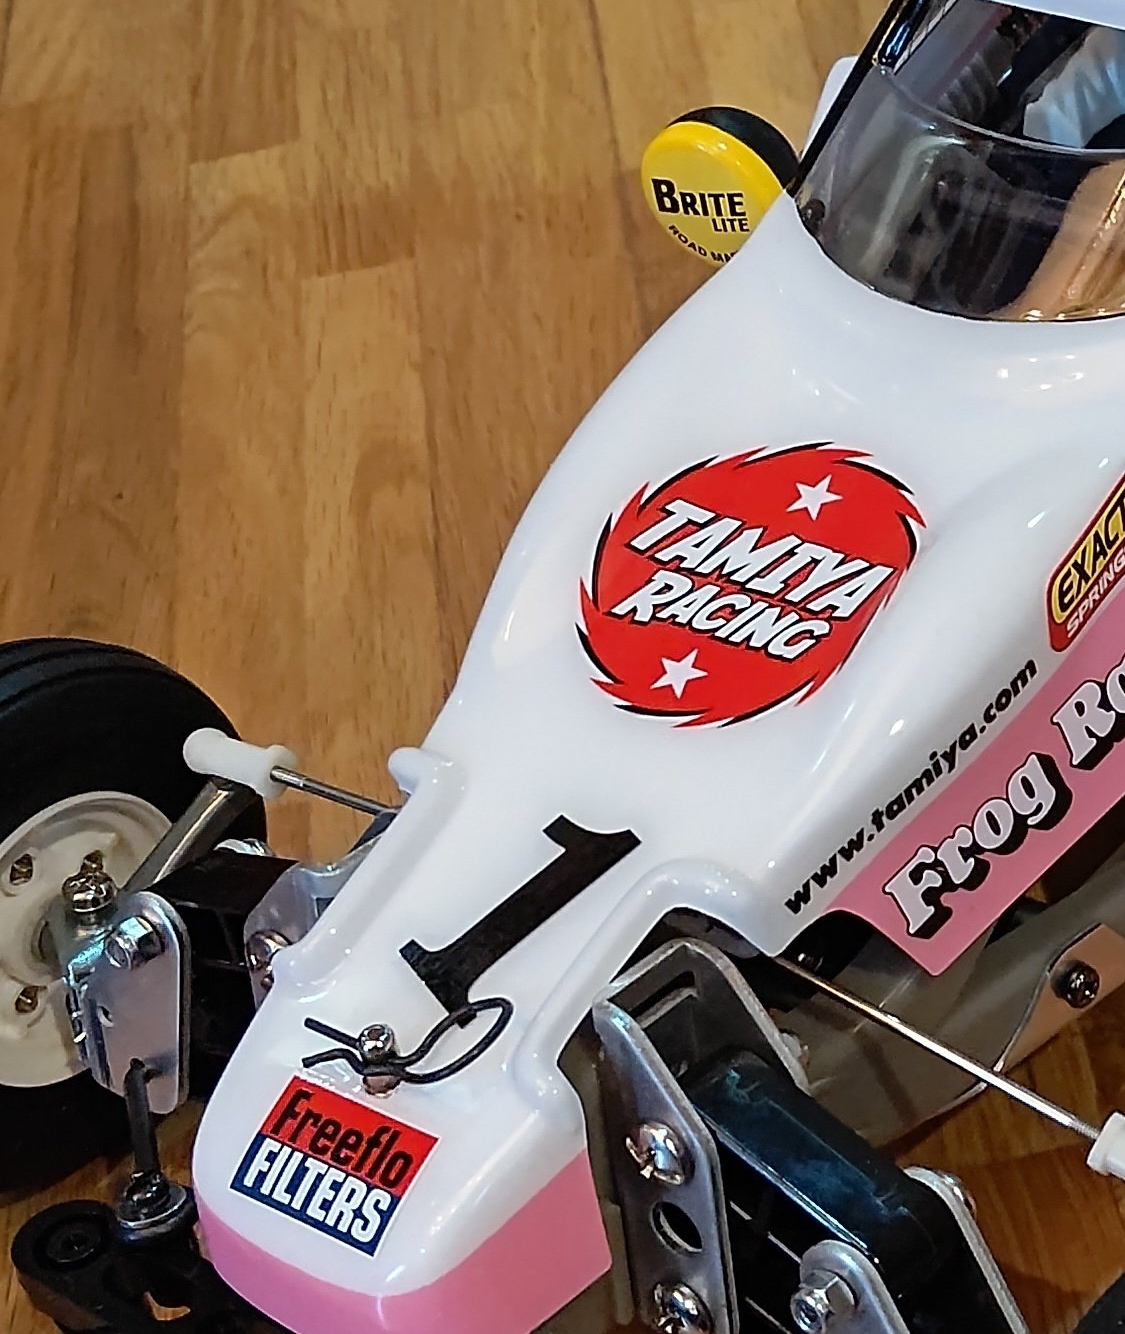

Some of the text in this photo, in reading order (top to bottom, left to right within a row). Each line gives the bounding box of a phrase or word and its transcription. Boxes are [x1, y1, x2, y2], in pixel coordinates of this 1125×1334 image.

[651, 178, 747, 217] BRITE
[668, 225, 708, 257] ROAD
[711, 218, 750, 233] LITE
[626, 498, 898, 619] TAMIYA
[608, 569, 832, 661] RACING
[784, 658, 1038, 915] www.tamiya.com
[883, 752, 1067, 937] Frog
[399, 814, 642, 1029] 1
[243, 1137, 392, 1243] FILTERS
[270, 1089, 414, 1190] Freeflo
